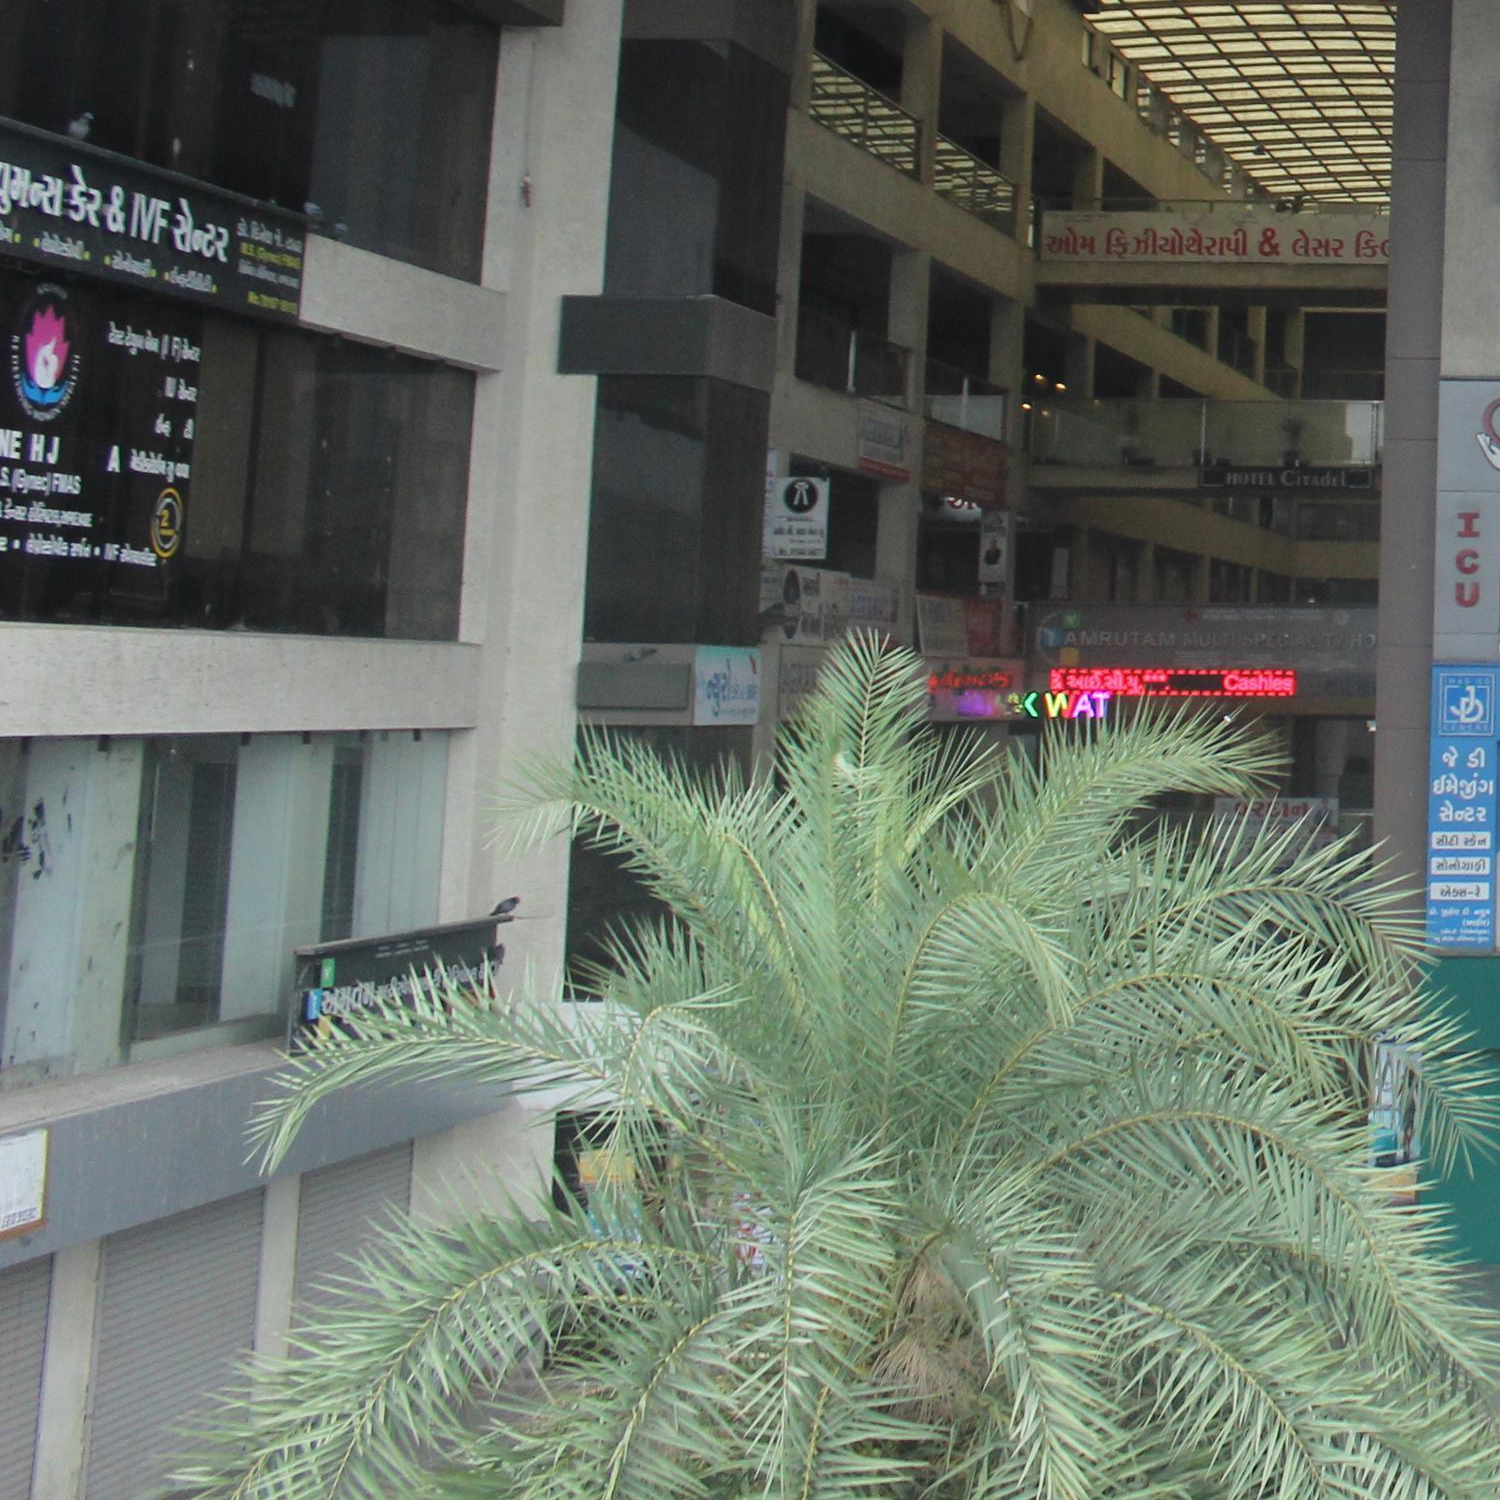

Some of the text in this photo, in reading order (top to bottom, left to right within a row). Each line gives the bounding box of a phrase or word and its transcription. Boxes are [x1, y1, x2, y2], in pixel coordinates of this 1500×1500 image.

[68, 164, 101, 227] કેર
[103, 185, 125, 234] &
[130, 192, 171, 244] IVF
[1046, 228, 1095, 257] ઓમ
[1259, 228, 1280, 256] &
[1292, 230, 1343, 258] લેસર
[1466, 746, 1486, 768] ડી
[1439, 800, 1486, 822] સેન્ટર
